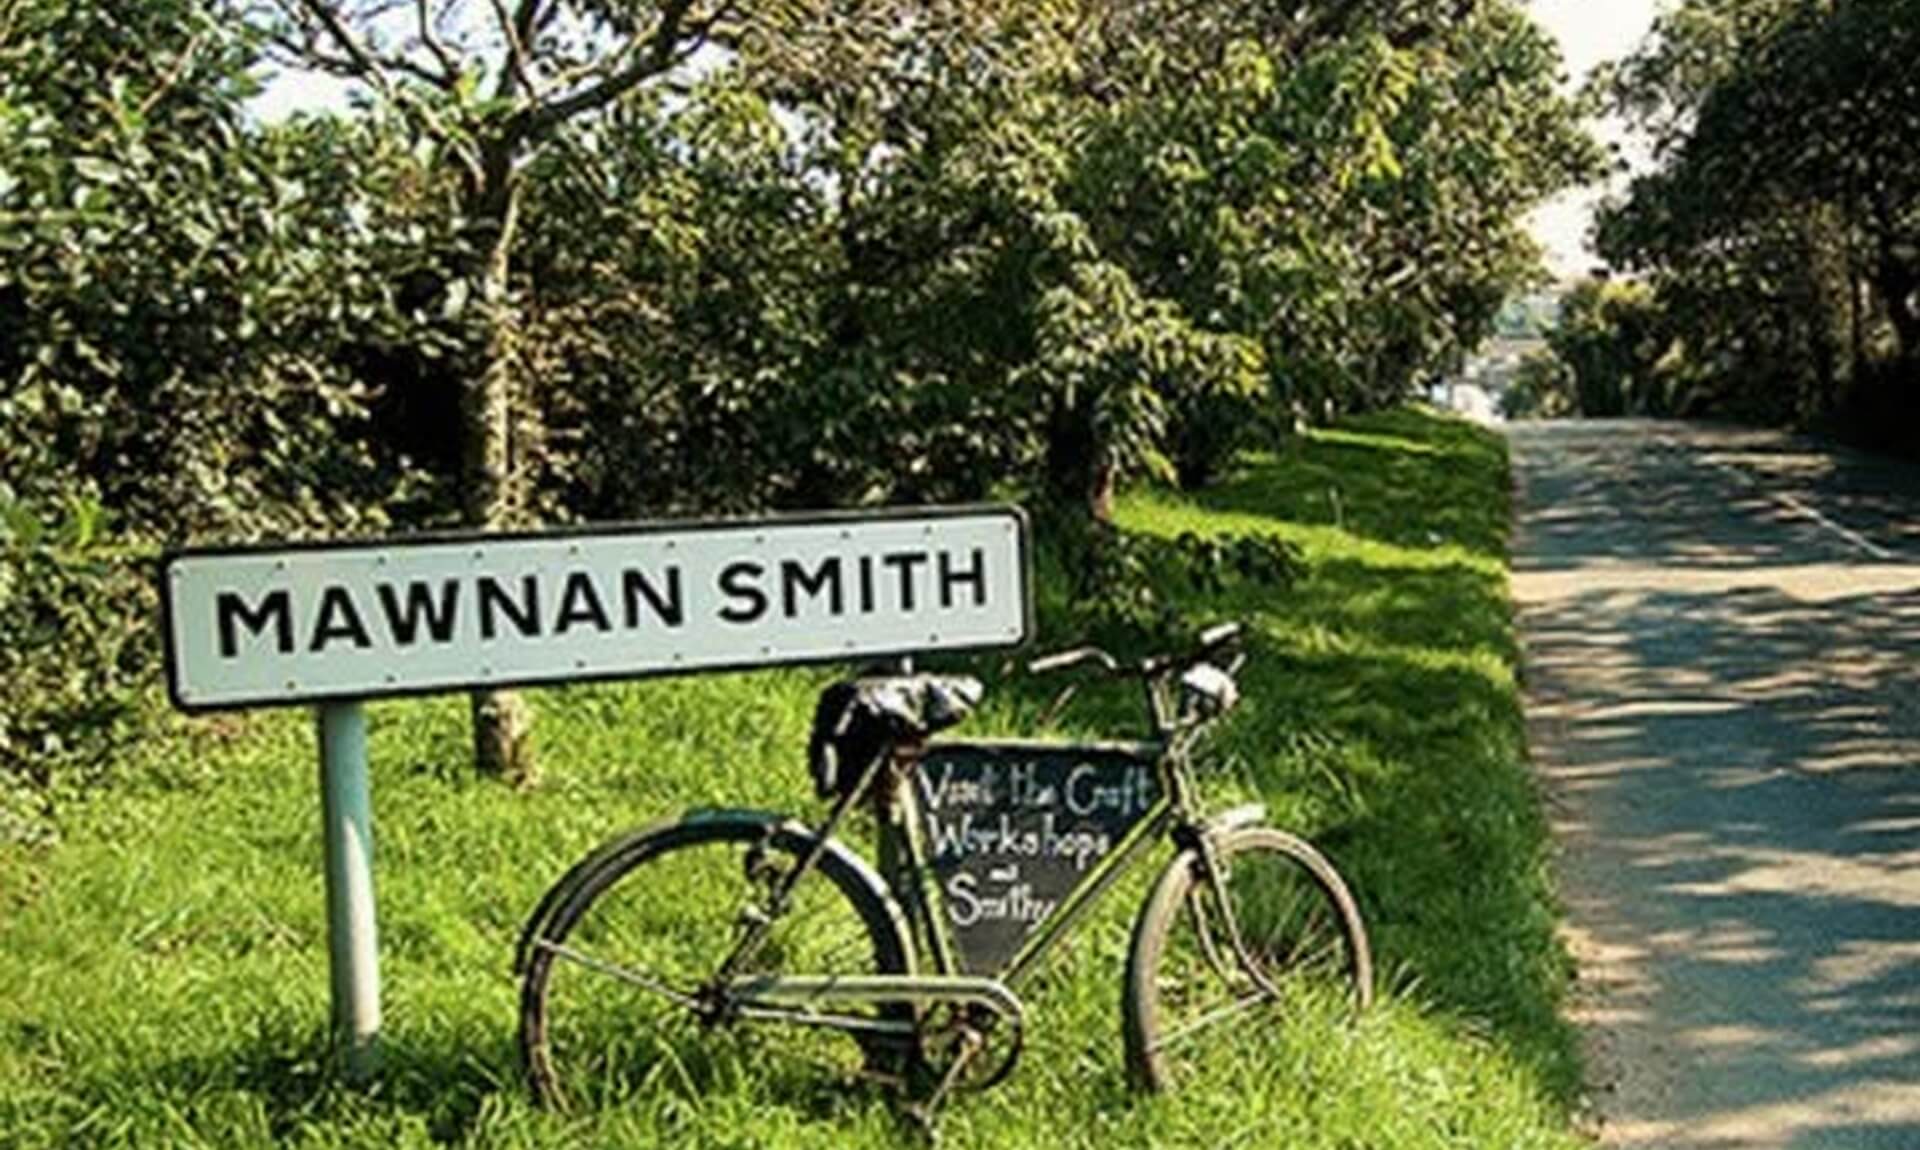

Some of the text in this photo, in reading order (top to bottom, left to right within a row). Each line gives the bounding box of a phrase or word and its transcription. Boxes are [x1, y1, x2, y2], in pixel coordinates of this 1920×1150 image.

[216, 547, 986, 658] MAWNAN SMITH
[1010, 762, 1056, 804] the
[1065, 763, 1151, 815] Craft
[926, 812, 1109, 870] Workshops
[947, 872, 1055, 933] Smithy
